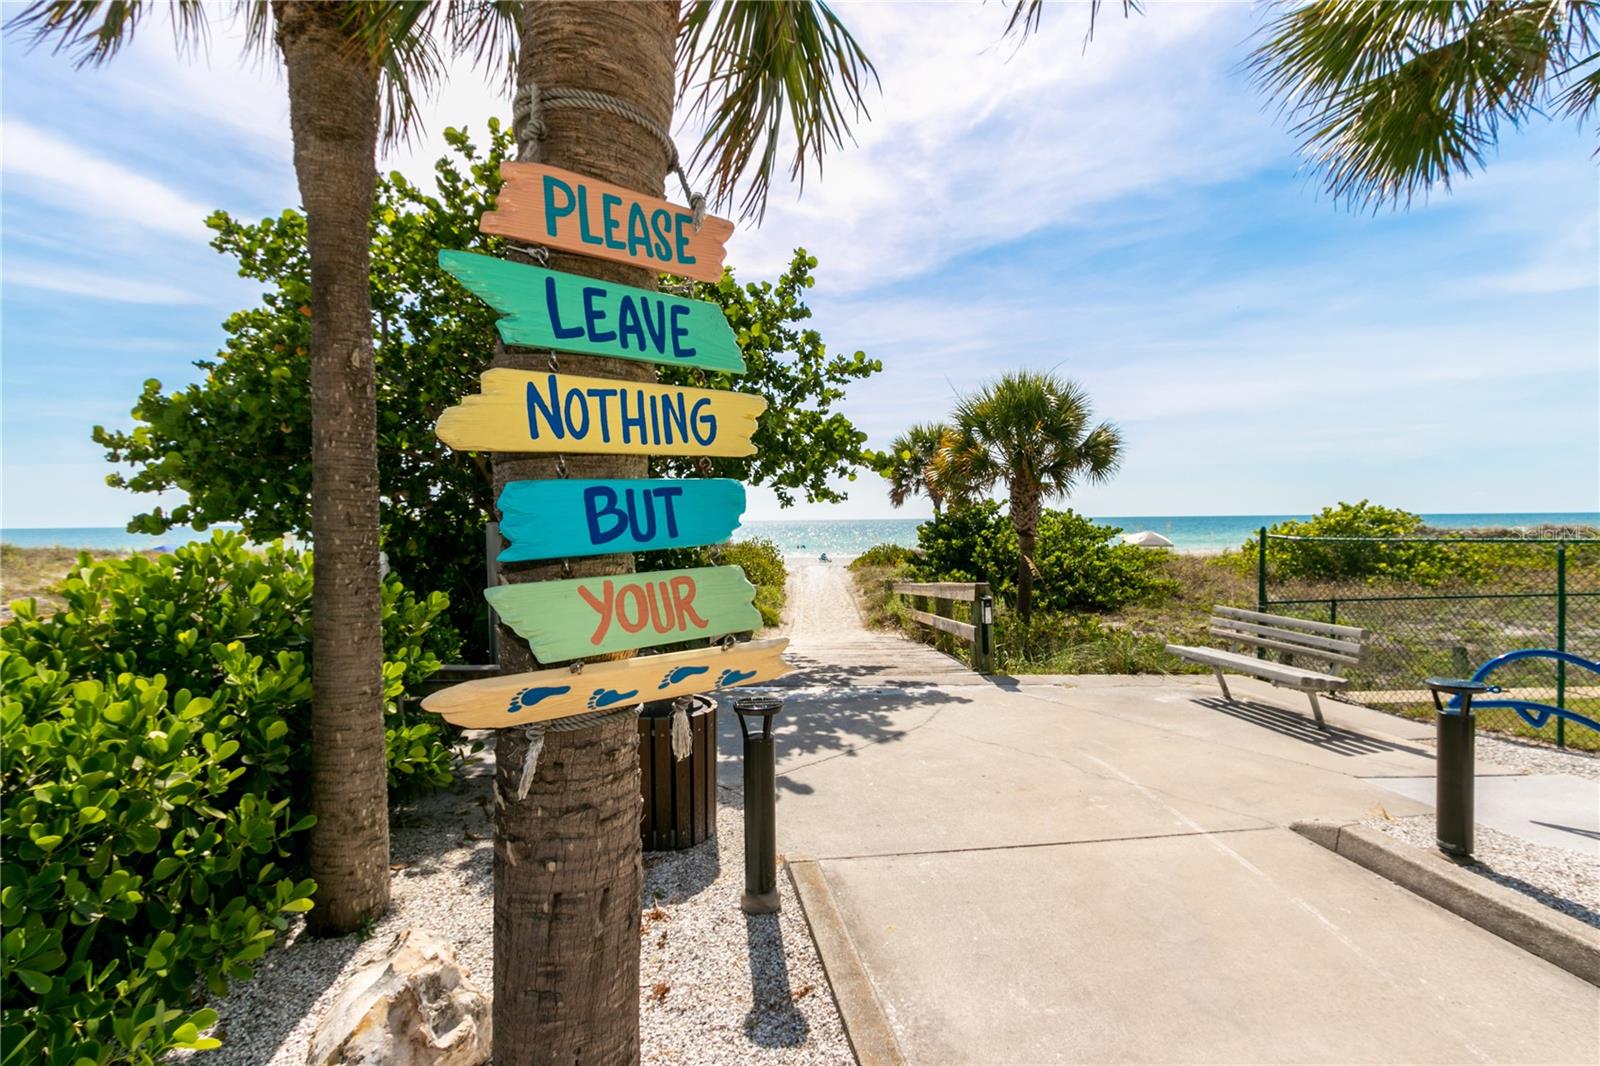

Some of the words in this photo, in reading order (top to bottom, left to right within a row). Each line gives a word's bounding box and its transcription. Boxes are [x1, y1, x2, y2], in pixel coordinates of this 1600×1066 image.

[542, 175, 697, 265] PLEASE
[545, 276, 697, 358] LEAVE
[526, 374, 717, 446] NOTHING
[583, 485, 683, 545] BUT
[577, 575, 709, 646] YOUR
